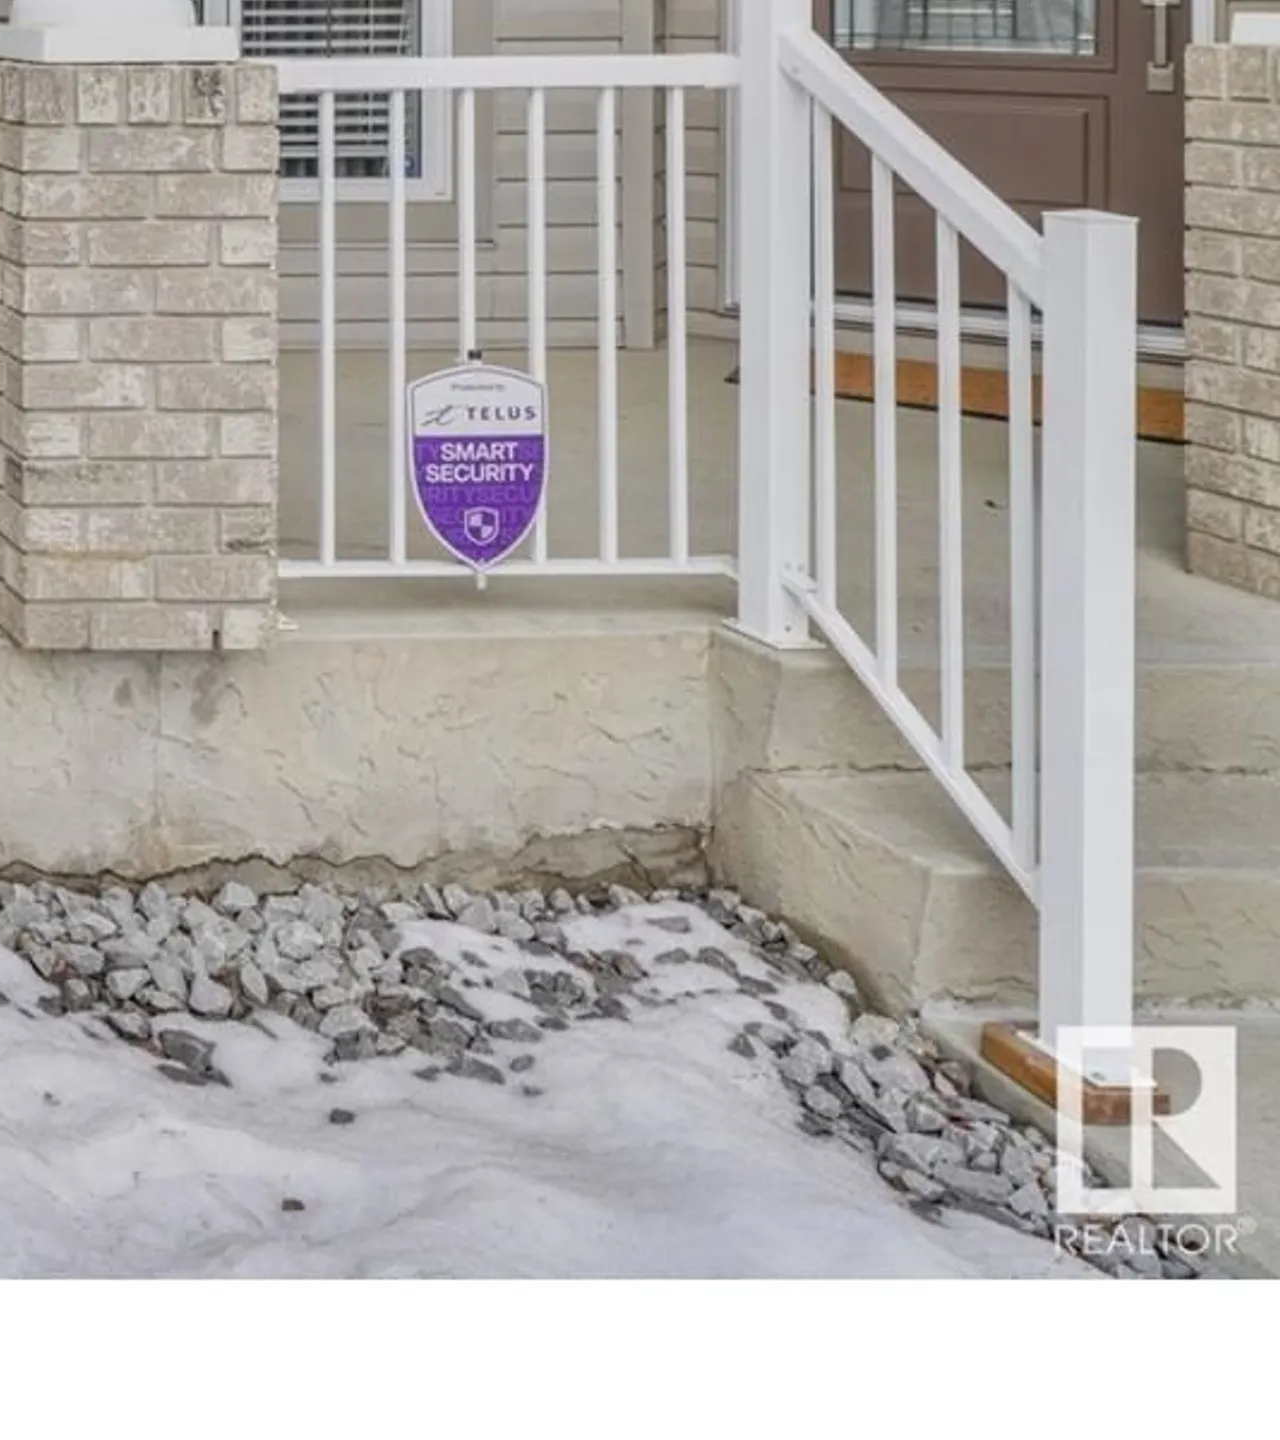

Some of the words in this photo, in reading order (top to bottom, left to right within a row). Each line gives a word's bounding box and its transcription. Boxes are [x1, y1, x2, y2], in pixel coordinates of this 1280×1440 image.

[466, 406, 537, 421] TELUS
[441, 442, 518, 461] SMART
[425, 463, 534, 483] SECURITY
